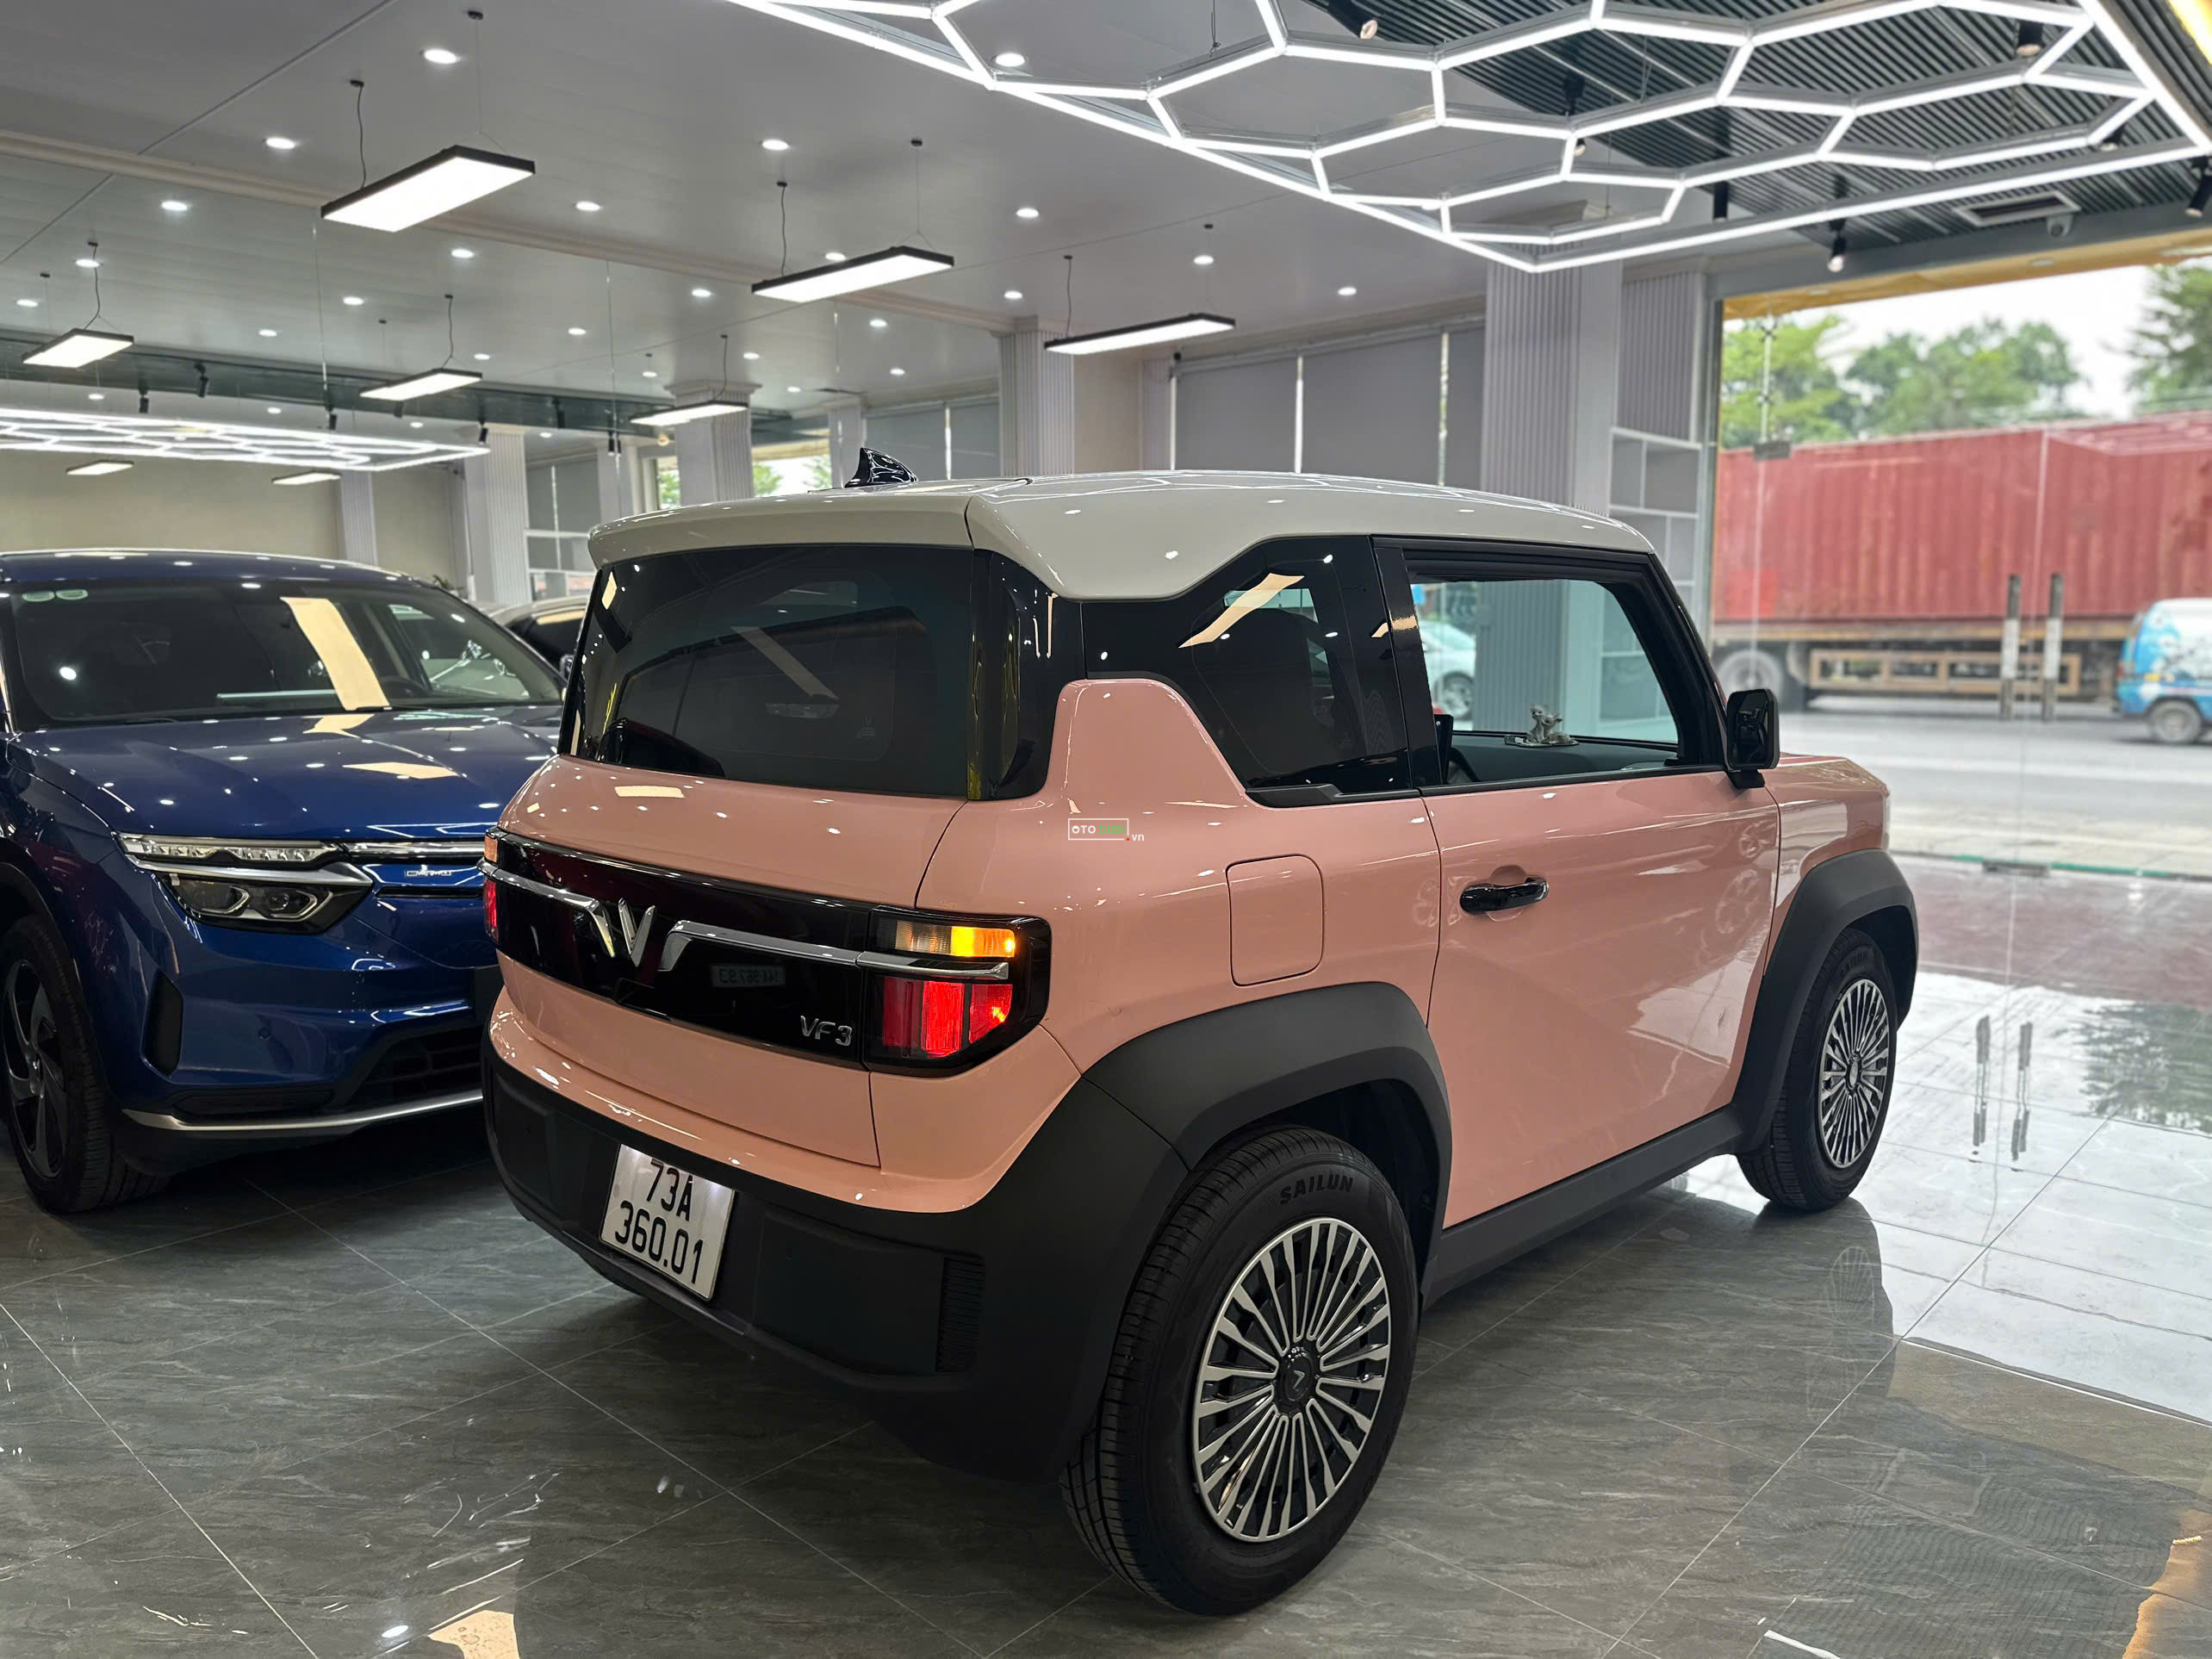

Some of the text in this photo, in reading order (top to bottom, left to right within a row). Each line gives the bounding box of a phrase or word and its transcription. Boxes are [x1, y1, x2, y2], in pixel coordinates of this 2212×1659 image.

[646, 1158, 693, 1221] 73A
[1280, 1173, 1353, 1206] SAILUN
[614, 1200, 704, 1284] 360.01
